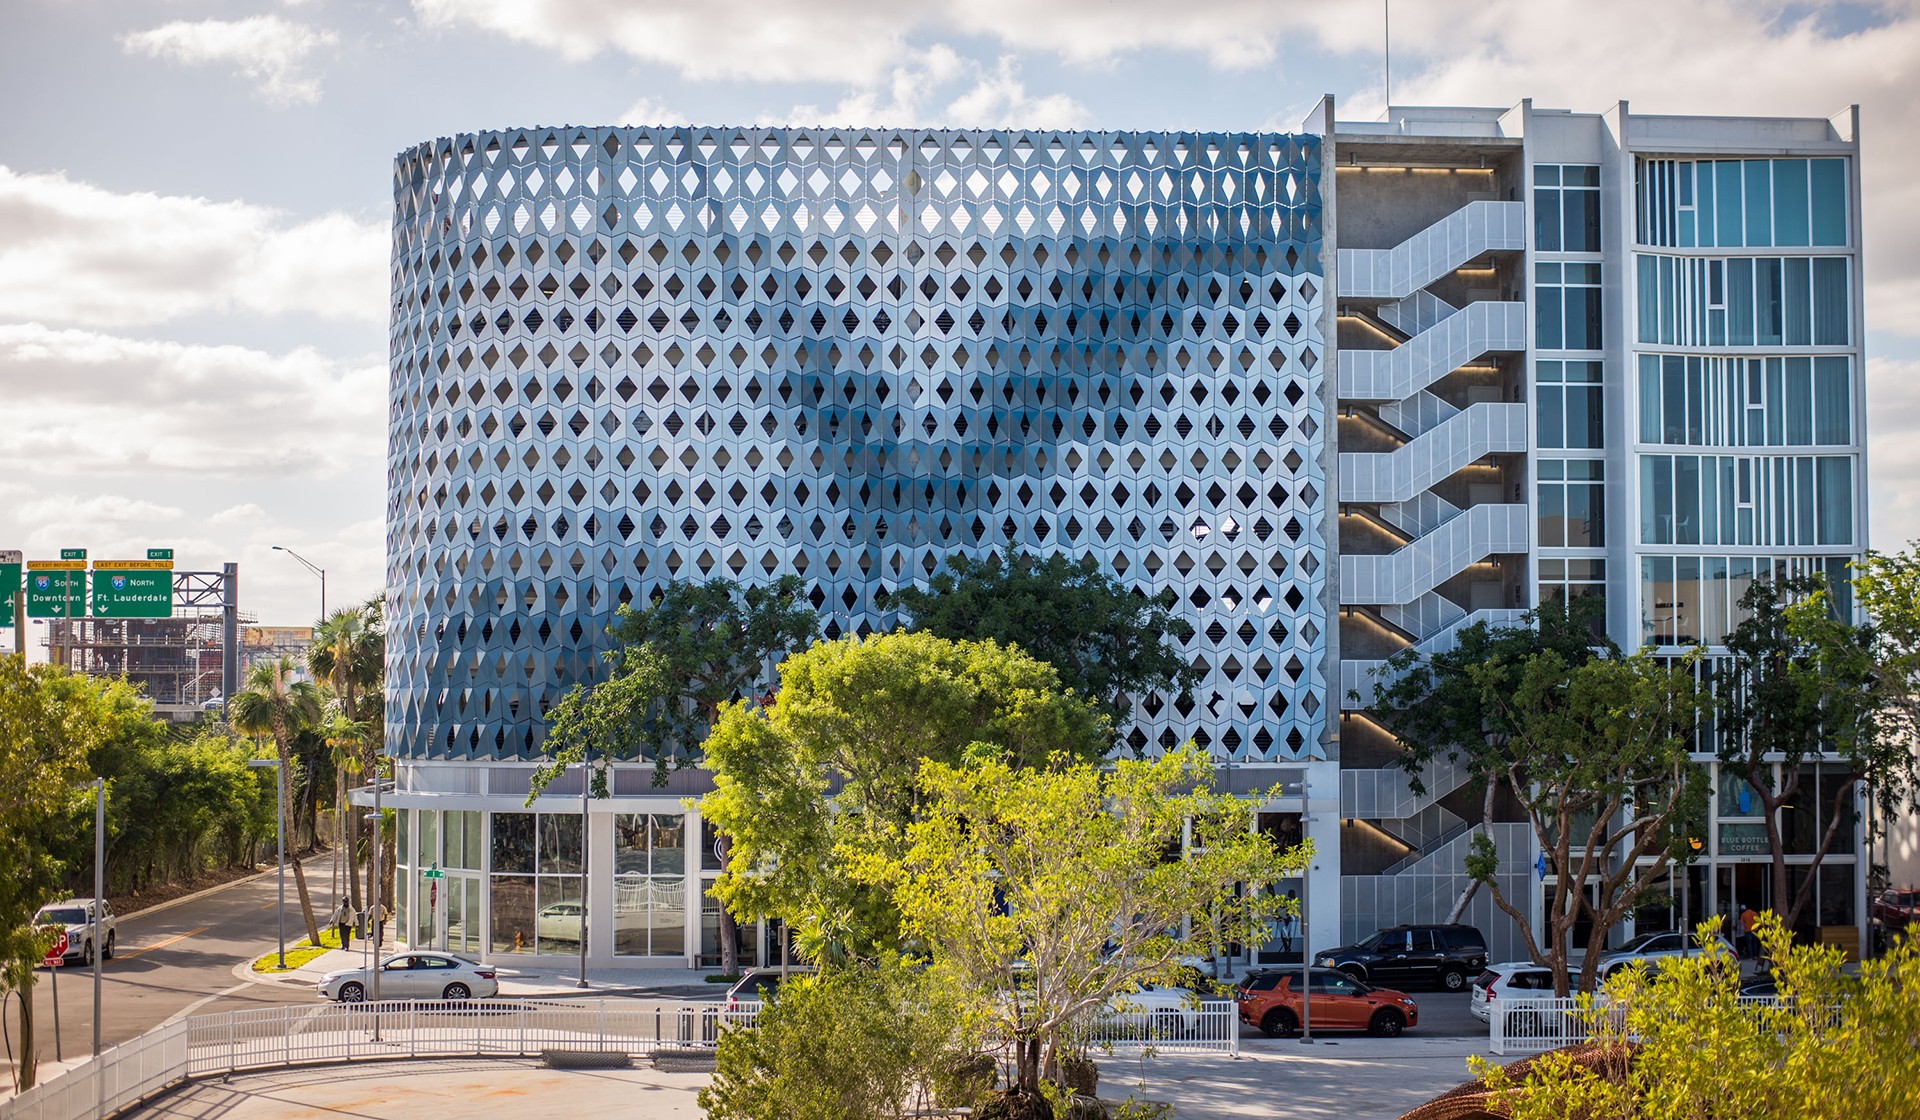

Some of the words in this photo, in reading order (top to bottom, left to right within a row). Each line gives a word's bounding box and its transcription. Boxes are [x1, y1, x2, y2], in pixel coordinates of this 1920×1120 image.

[167, 550, 171, 558] 1
[113, 579, 123, 587] 95
[33, 594, 80, 602] Downtown
[97, 594, 110, 602] Ft.
[114, 594, 167, 602] Lauderdale
